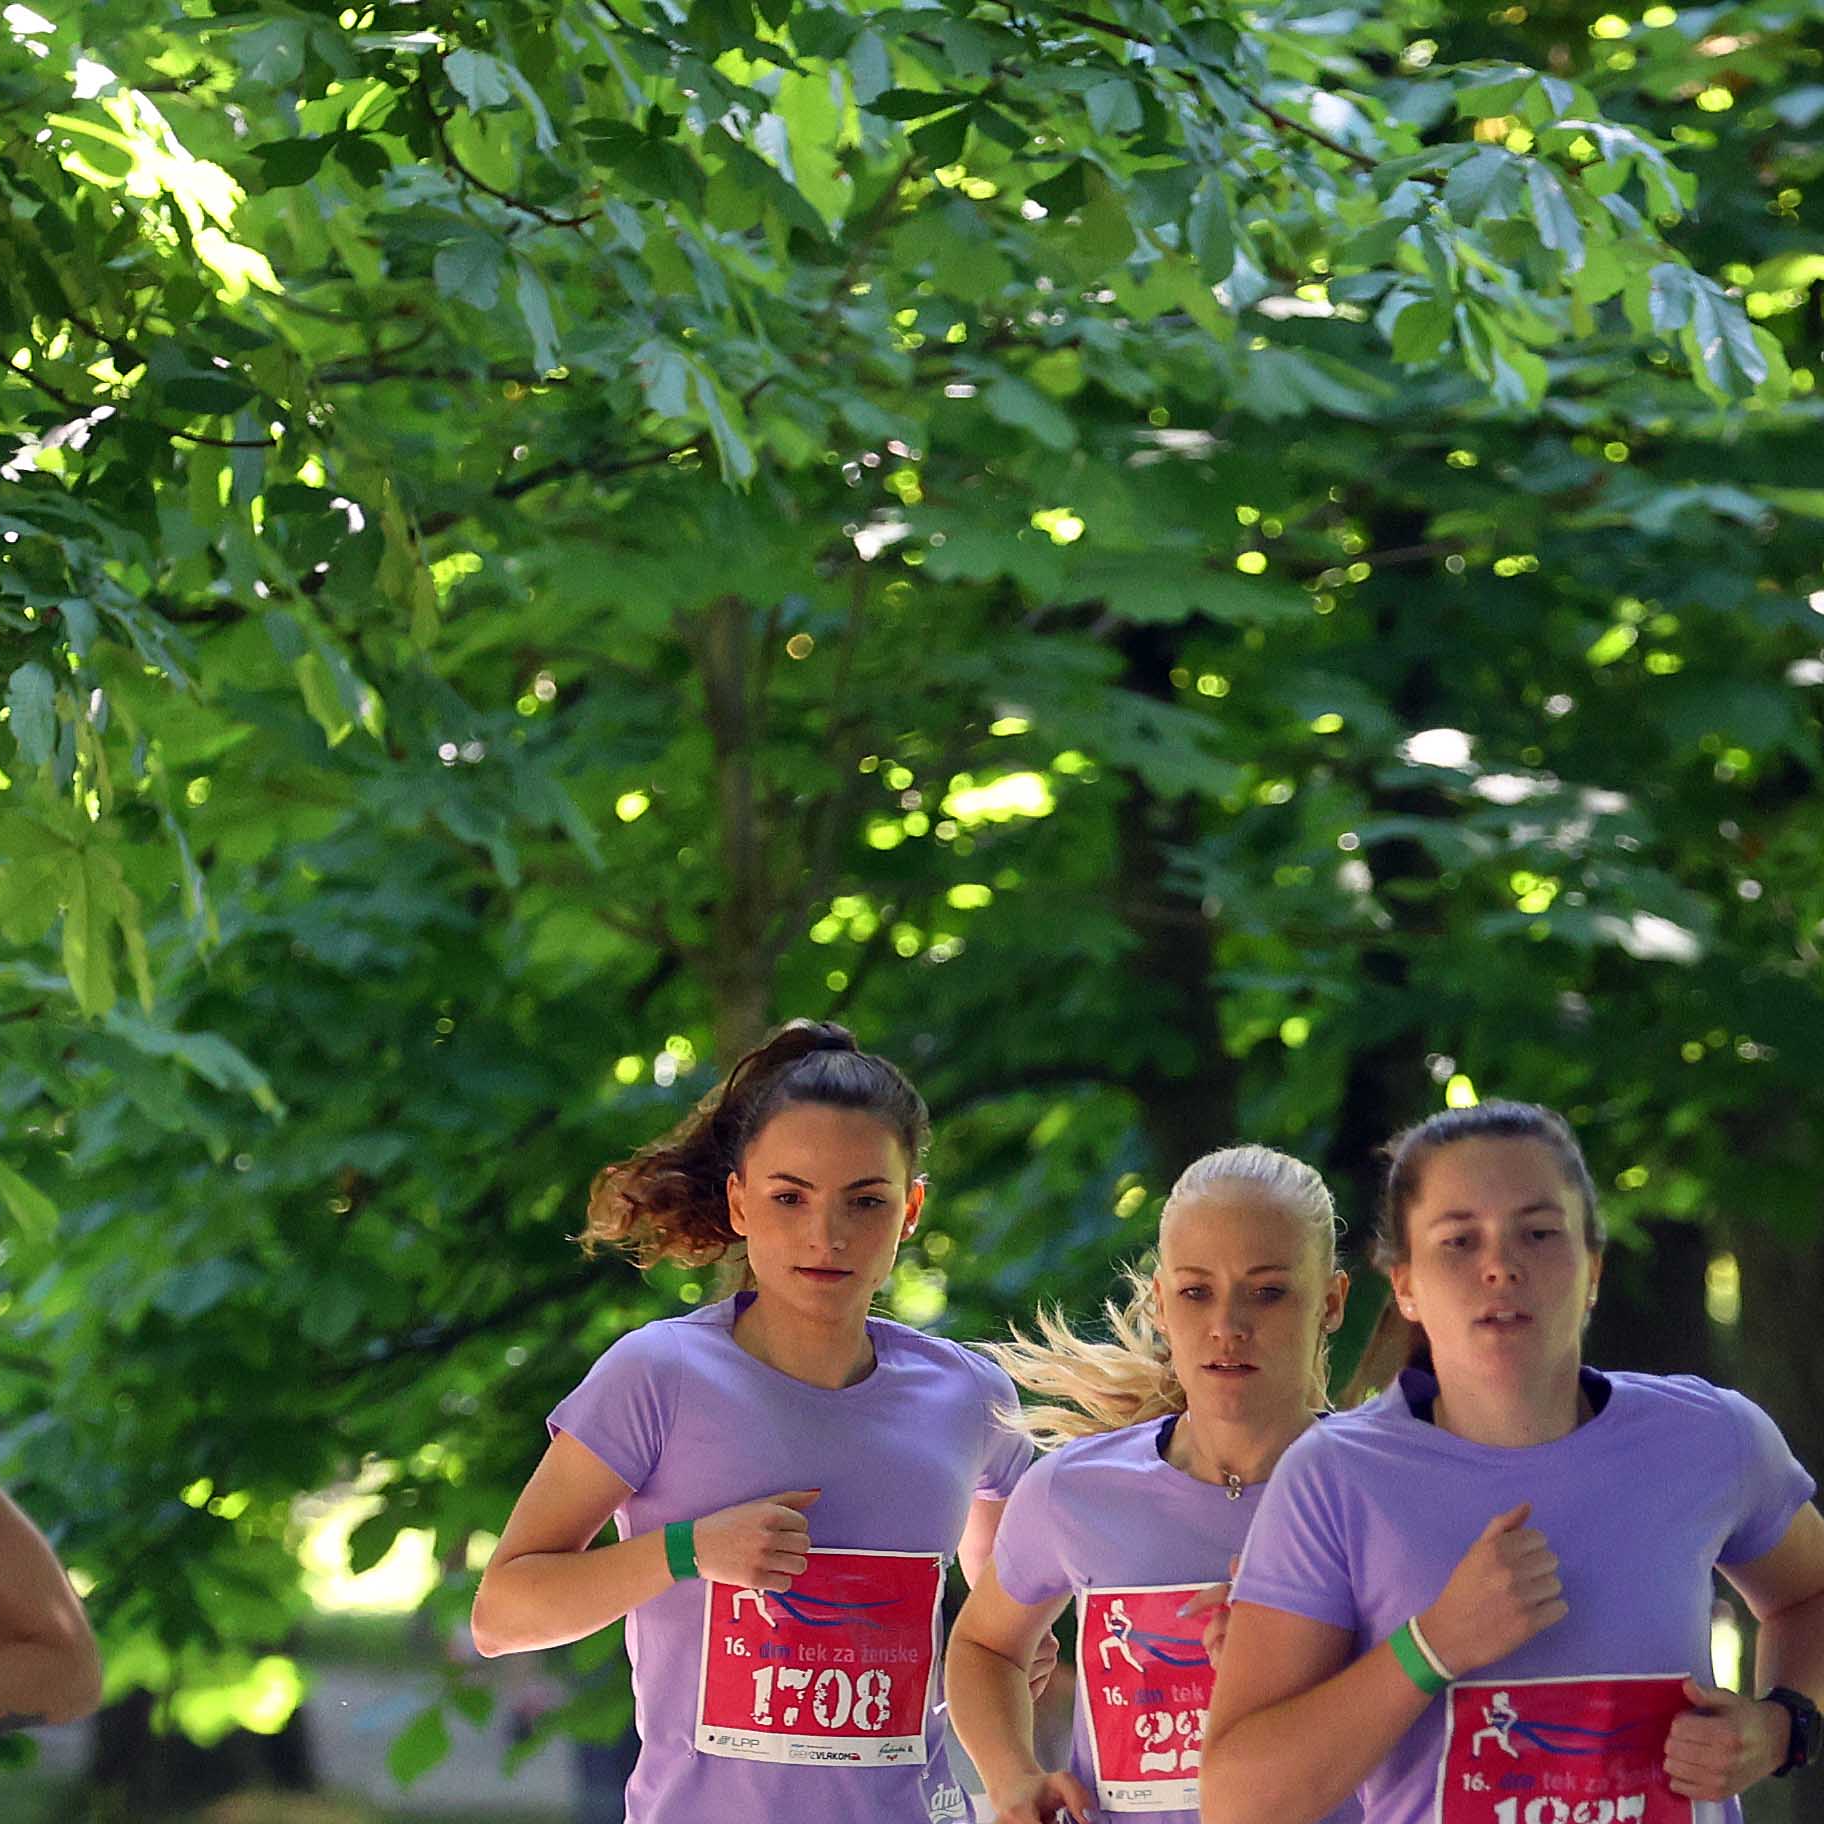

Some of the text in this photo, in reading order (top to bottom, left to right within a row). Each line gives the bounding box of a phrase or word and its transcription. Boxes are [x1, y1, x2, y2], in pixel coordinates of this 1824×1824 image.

[724, 1636, 751, 1657] 16.
[798, 1643, 826, 1662] tek
[832, 1647, 856, 1662] za
[861, 1645, 918, 1663] ženske
[750, 1665, 892, 1731] 1708
[1102, 1686, 1128, 1706] 16.
[1171, 1682, 1205, 1702] tek
[731, 1738, 760, 1748] LPP
[1463, 1773, 1491, 1791] 16.
